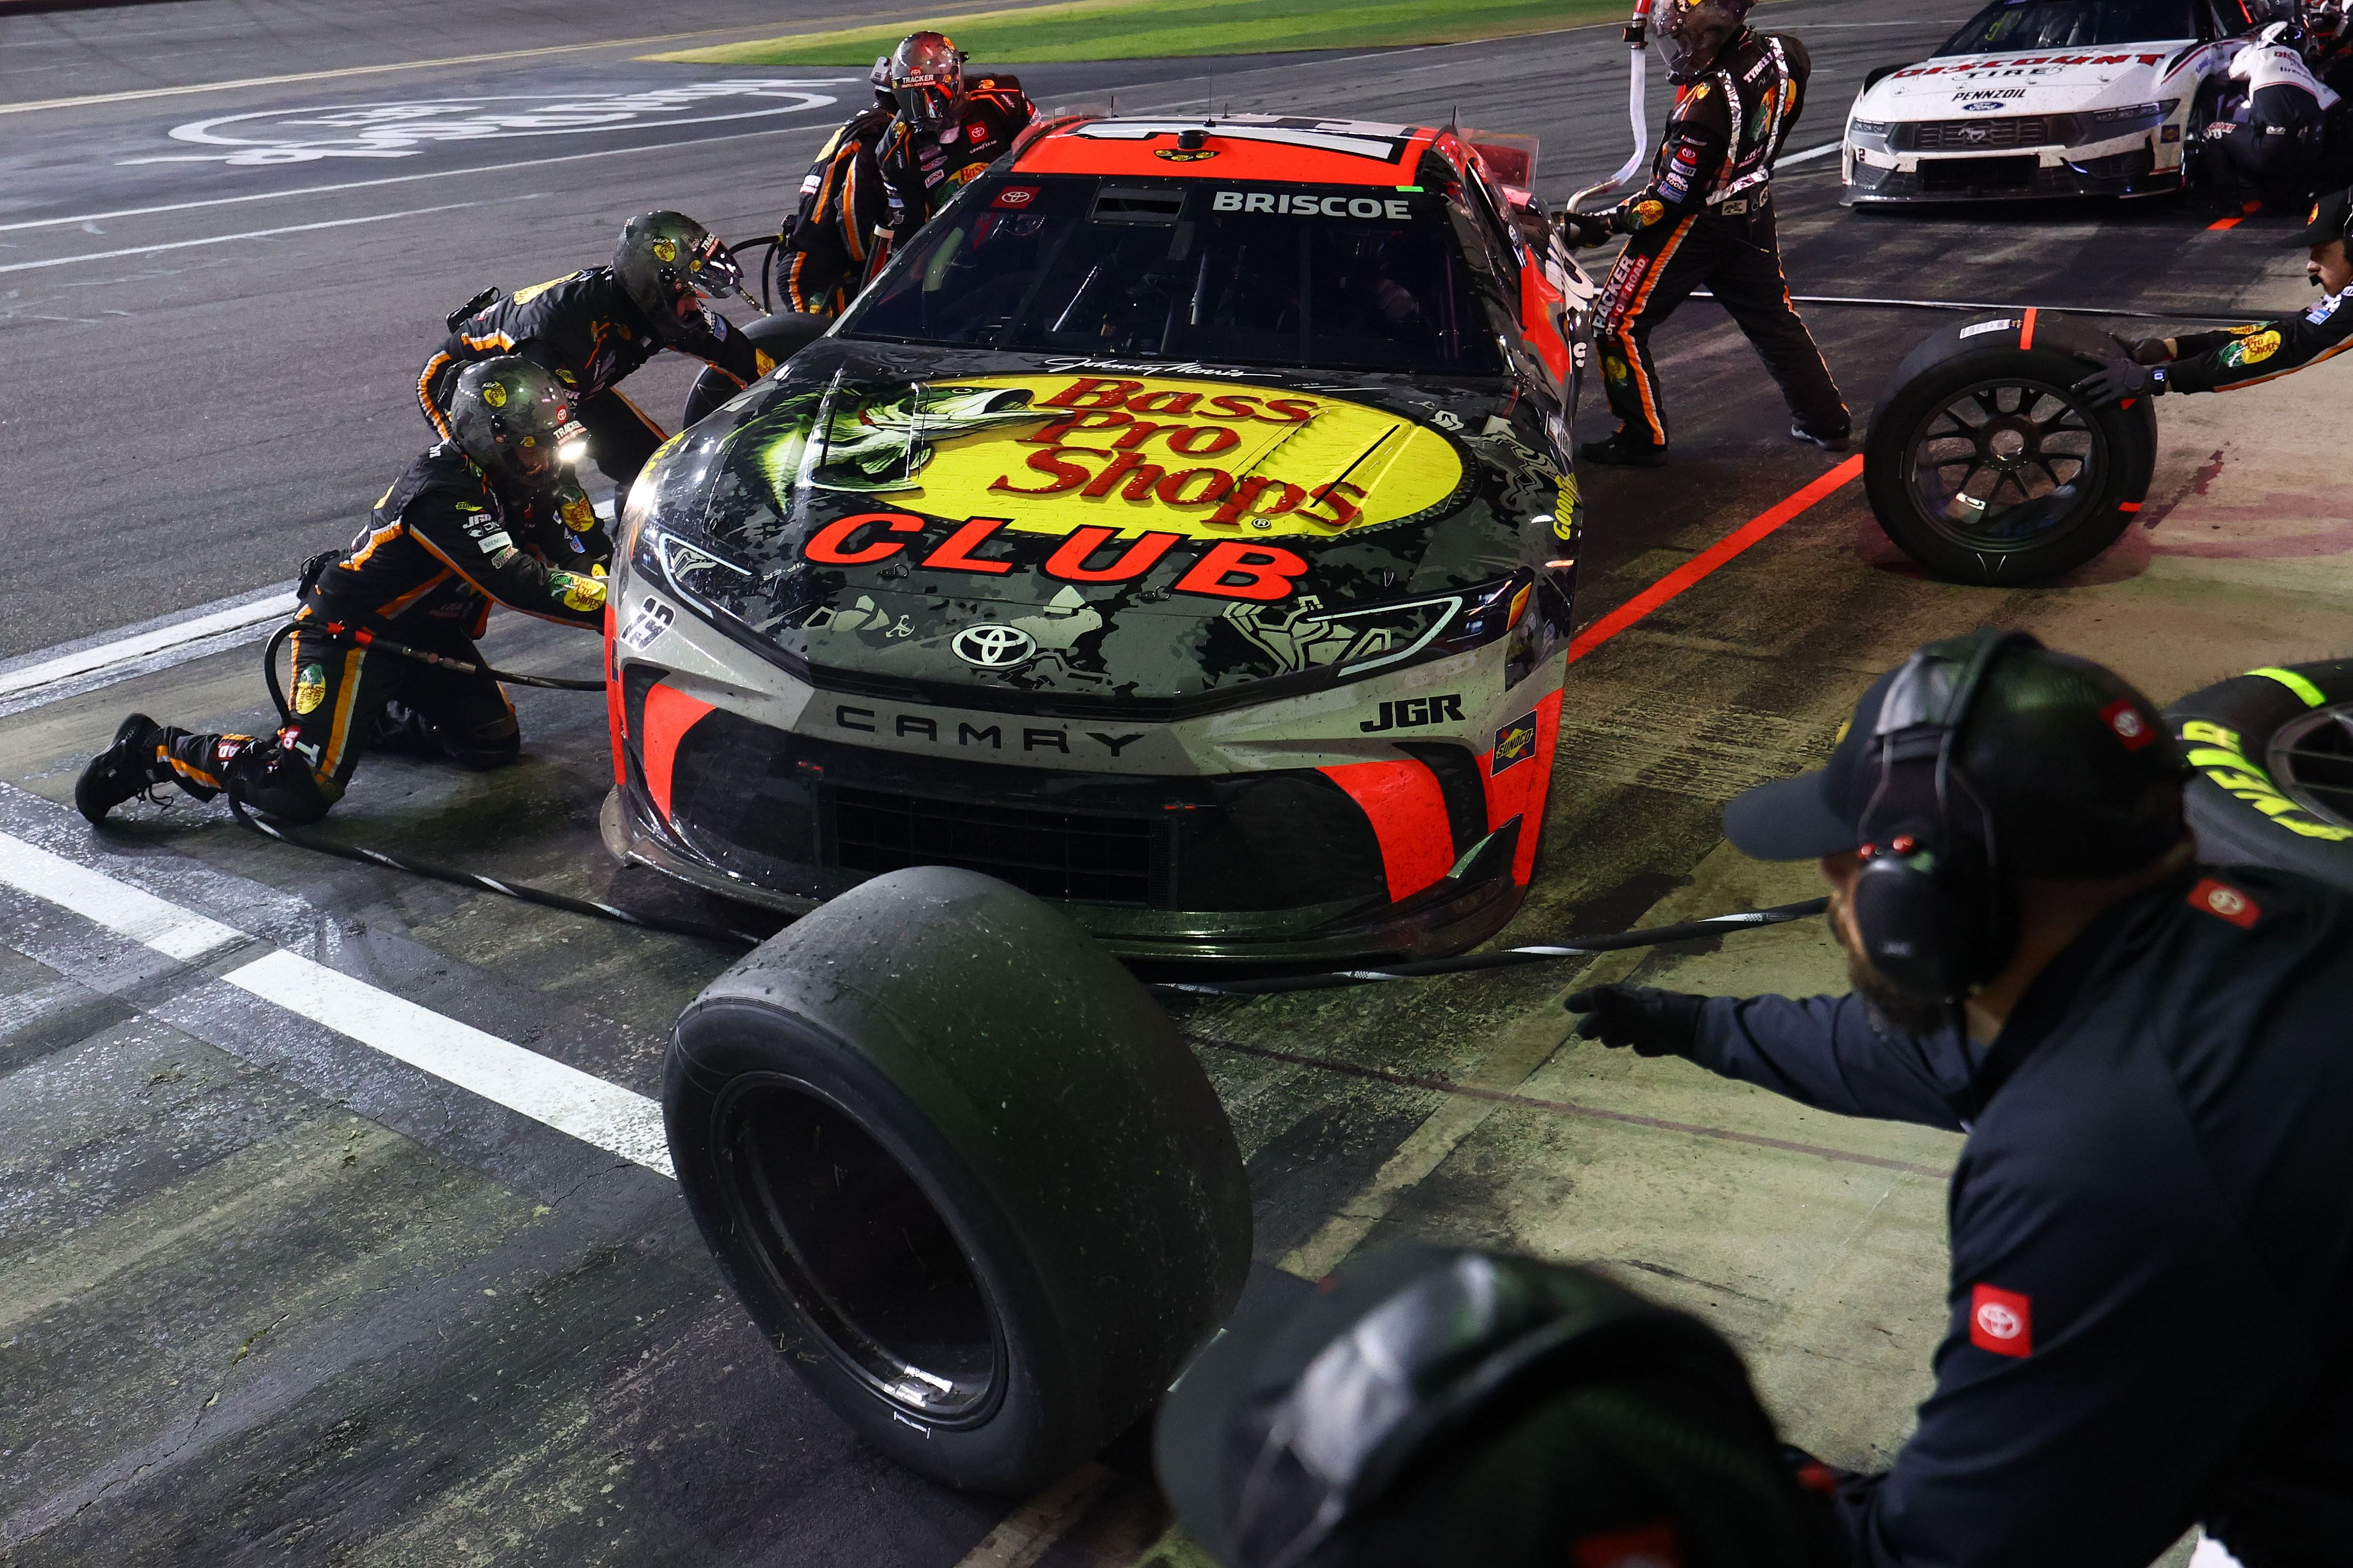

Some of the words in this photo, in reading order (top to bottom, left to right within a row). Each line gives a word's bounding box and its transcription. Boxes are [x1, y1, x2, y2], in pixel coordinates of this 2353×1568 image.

[902, 75, 934, 83] TRACKER
[1893, 54, 2165, 79] DISCOUNT
[1965, 68, 2049, 79] TIRE
[528, 78, 861, 111] Hard
[1952, 89, 2027, 102] PENNZOIL
[277, 106, 485, 127] BET
[114, 113, 637, 166] Rock
[1859, 148, 1865, 162] 2
[1212, 191, 1412, 220] BRISCOE
[1625, 258, 1646, 293] ROAD
[1592, 255, 1633, 338] TRACKER
[1044, 357, 1159, 376] Johnny
[1140, 362, 1282, 377] Morris
[1032, 377, 1319, 424] Bass
[1015, 409, 1241, 455] Pro
[987, 447, 1369, 527] Shops
[803, 513, 1309, 601] CLUB
[573, 592, 602, 609] Shops
[313, 686, 325, 706] Bass
[1360, 694, 1466, 732] JGR
[836, 705, 1146, 757] CAMRY
[1496, 728, 1534, 760] SUNOCO
